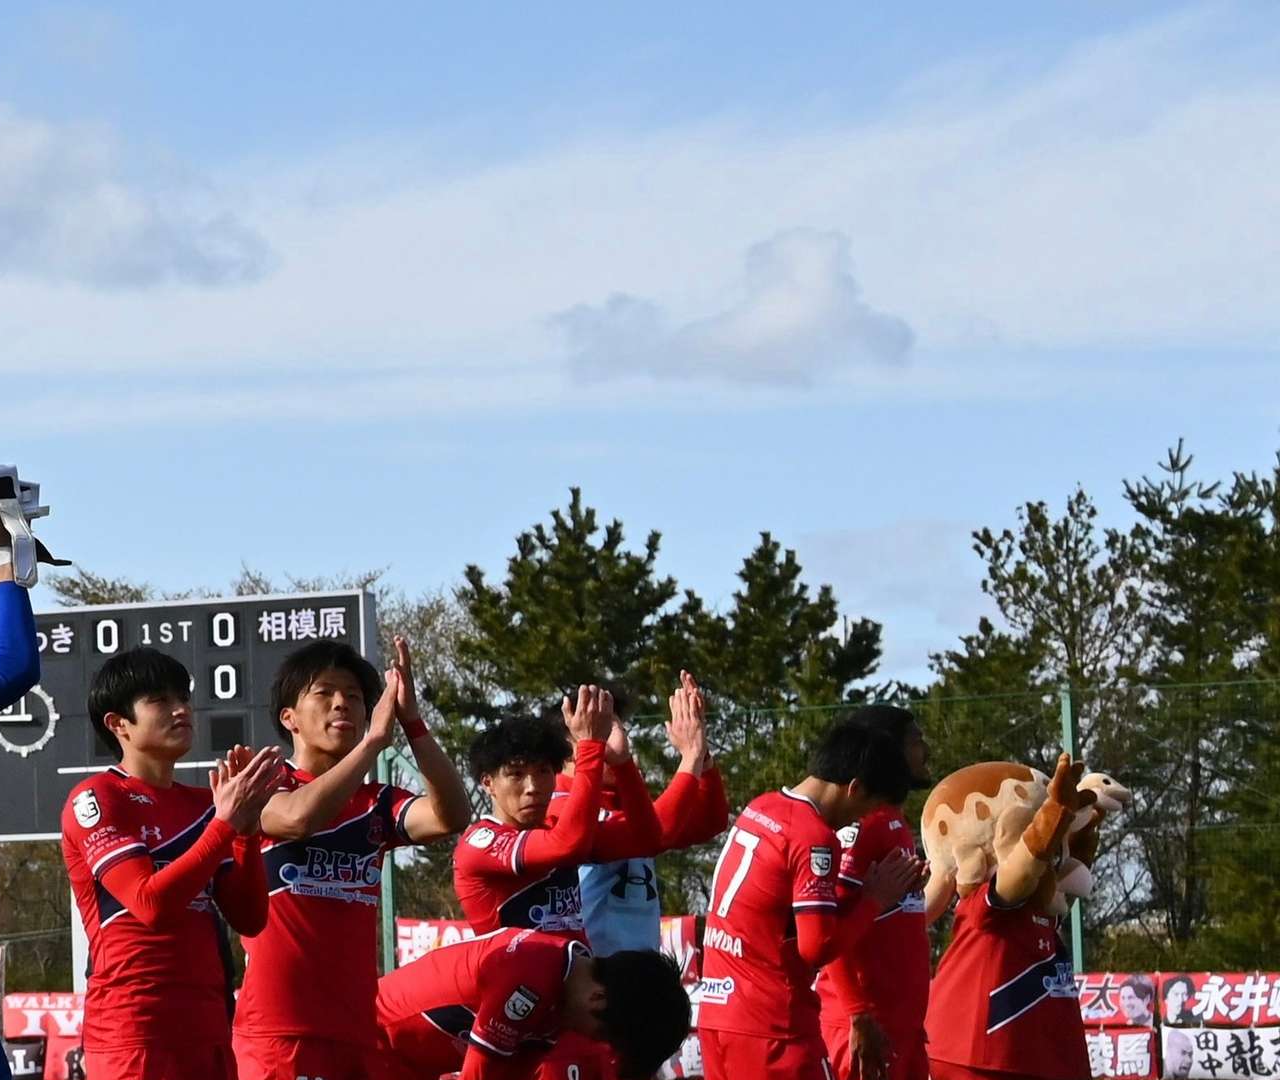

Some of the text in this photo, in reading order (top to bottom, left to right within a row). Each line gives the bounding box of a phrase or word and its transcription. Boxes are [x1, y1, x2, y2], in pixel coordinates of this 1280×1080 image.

[96, 619, 119, 654] 0
[141, 621, 193, 645] 1ST
[212, 612, 236, 648] 0
[258, 607, 347, 643] 相模原
[214, 664, 238, 700] 0
[707, 825, 761, 919] 17
[6, 995, 72, 1009] WALK
